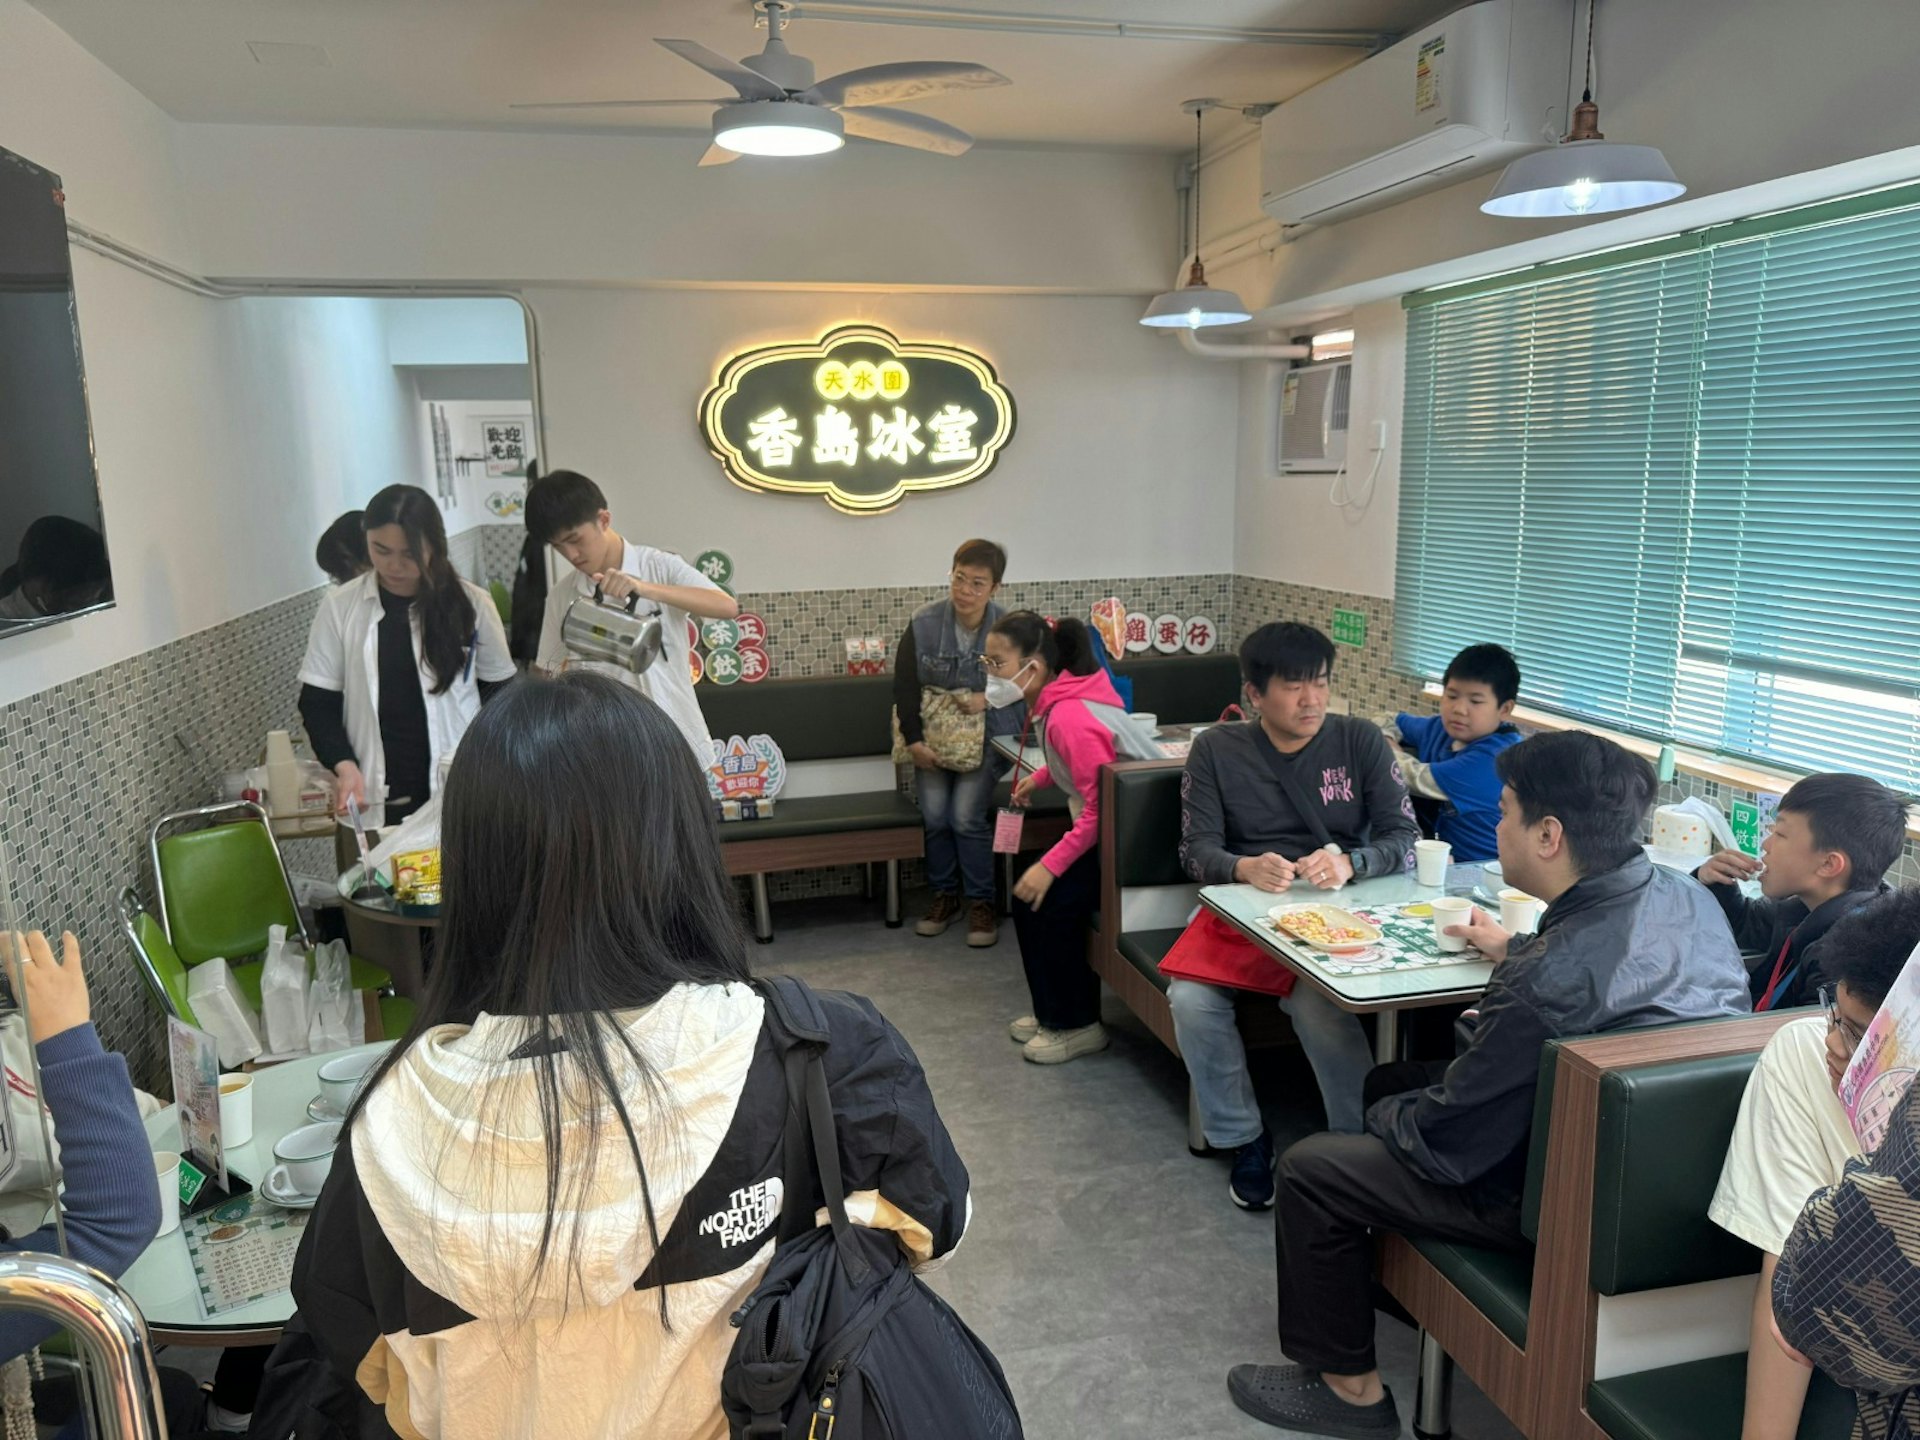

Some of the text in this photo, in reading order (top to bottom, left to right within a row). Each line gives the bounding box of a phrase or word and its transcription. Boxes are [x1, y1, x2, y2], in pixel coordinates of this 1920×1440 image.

[825, 371, 901, 391] 天水圍
[747, 404, 979, 467] 香島冰室
[1126, 618, 1210, 646] 雞蛋仔
[723, 755, 757, 774] 香島
[1322, 766, 1346, 786] NEW
[1319, 777, 1354, 806] YORK
[729, 1181, 765, 1209] THE
[699, 1200, 765, 1235] NORTH
[720, 1217, 765, 1248] FACE
